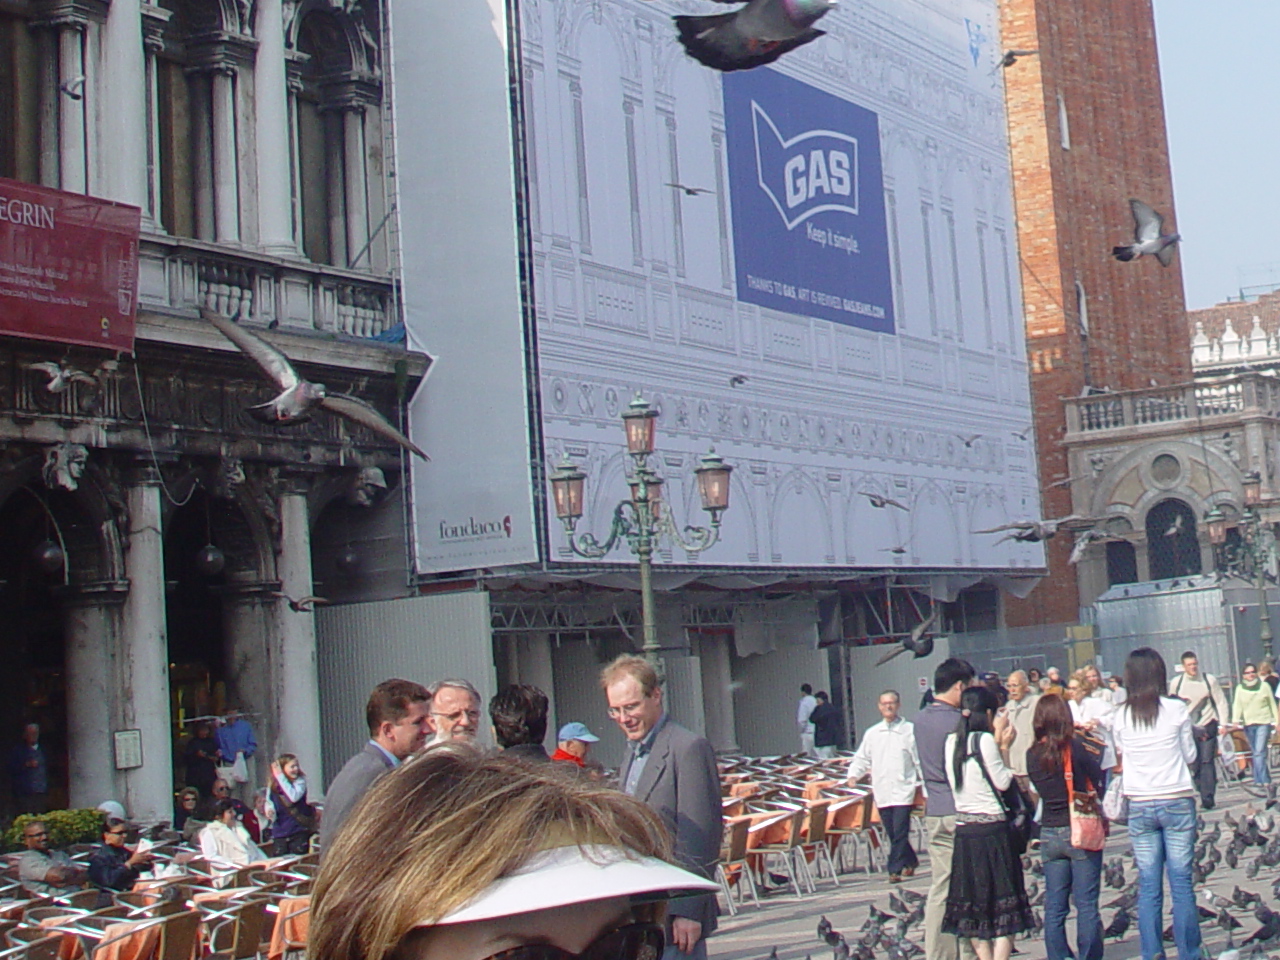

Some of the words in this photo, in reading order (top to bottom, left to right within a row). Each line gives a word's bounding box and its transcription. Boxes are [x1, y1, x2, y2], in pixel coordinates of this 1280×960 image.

[784, 149, 851, 209] GAS
[806, 221, 826, 248] Keep
[746, 274, 773, 294] THANKS
[774, 281, 782, 295] TO
[440, 516, 501, 539] fondaco
